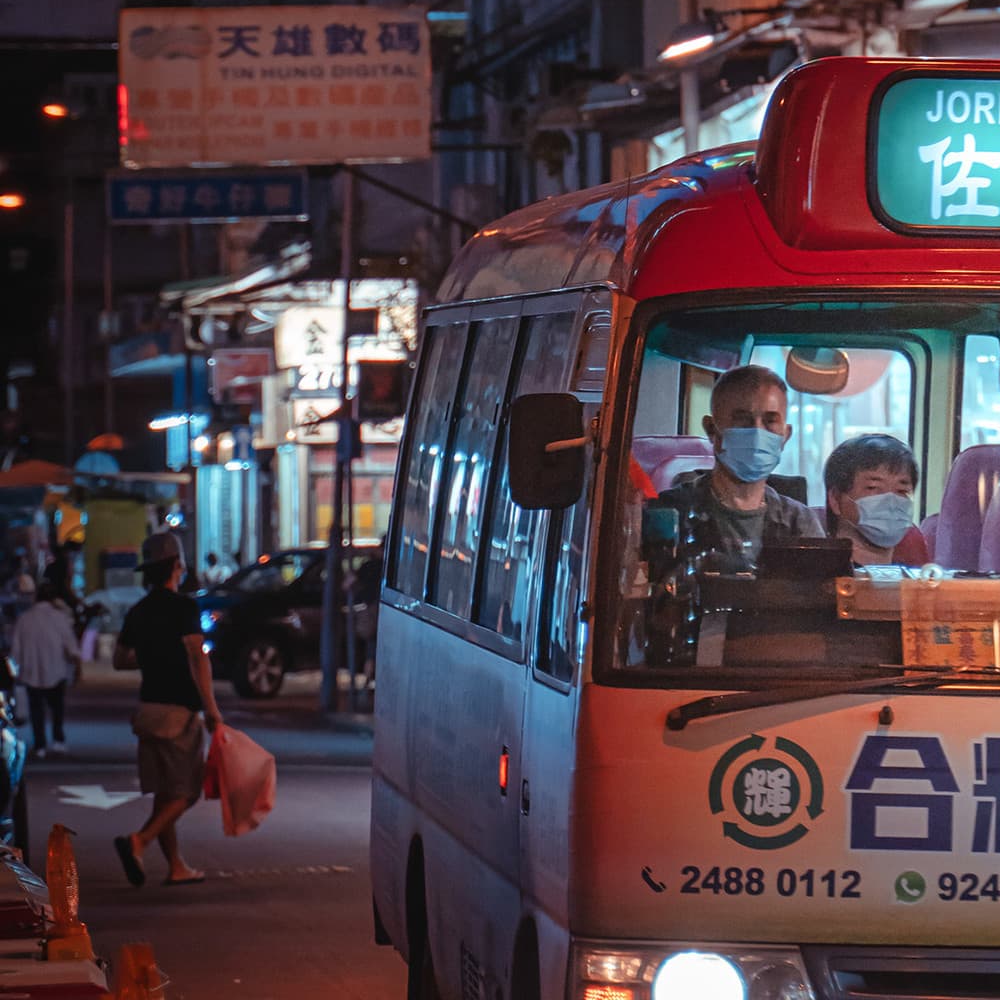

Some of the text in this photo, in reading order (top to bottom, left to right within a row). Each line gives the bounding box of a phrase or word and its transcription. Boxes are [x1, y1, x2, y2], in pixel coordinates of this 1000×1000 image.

[217, 22, 420, 59] 天雄數碼
[219, 63, 419, 80] TIN HUNG DIGITAL
[680, 866, 862, 898] 2488 0112
